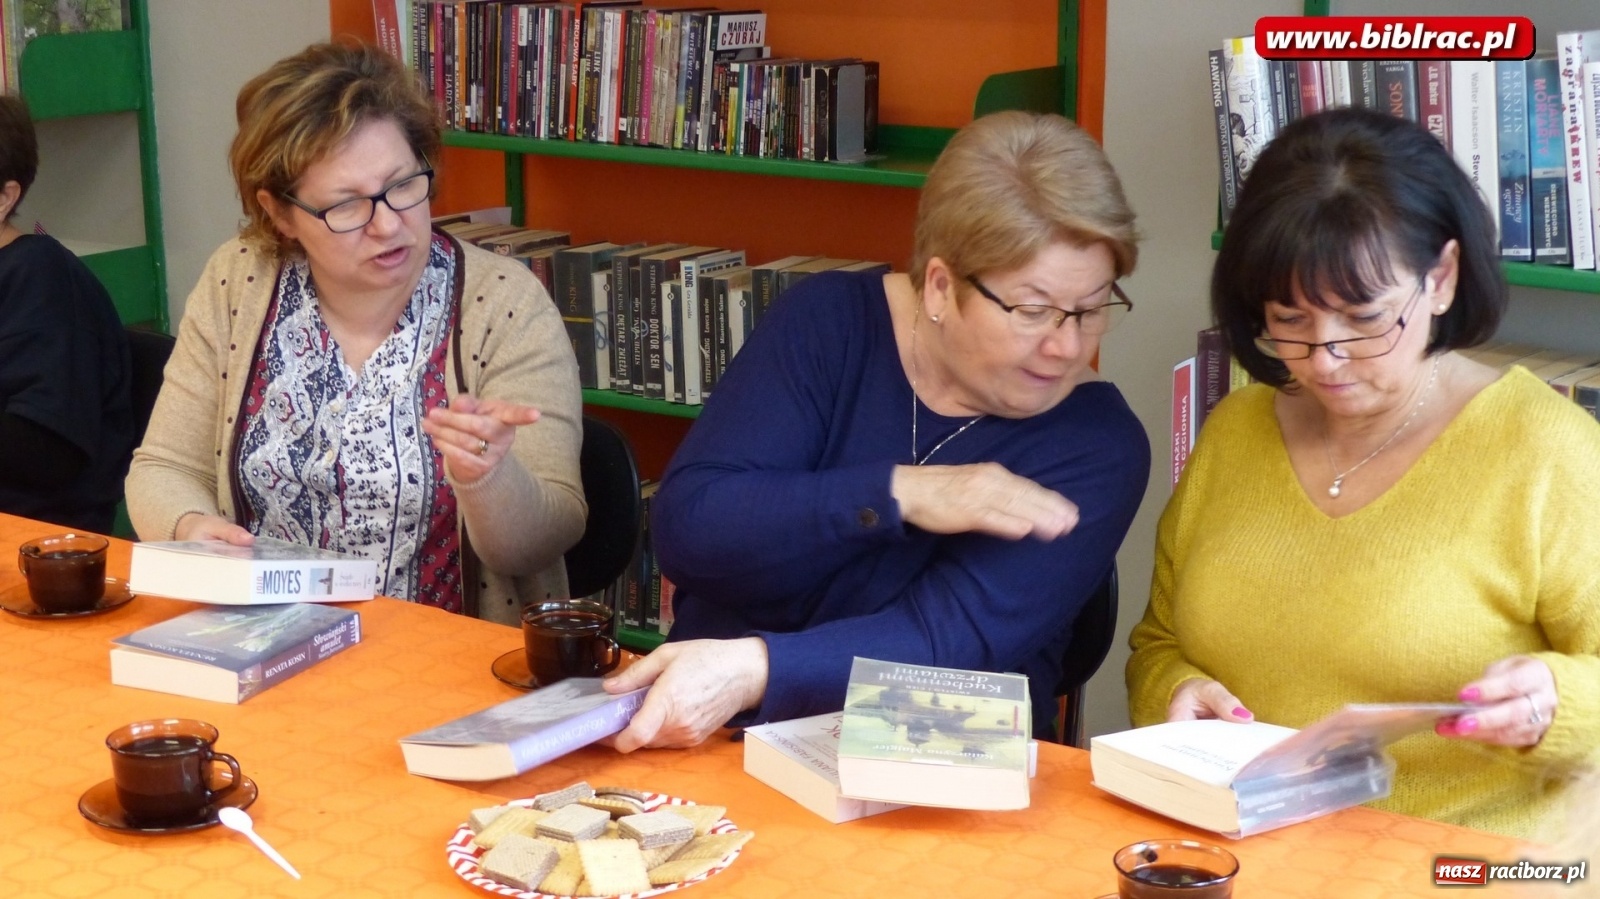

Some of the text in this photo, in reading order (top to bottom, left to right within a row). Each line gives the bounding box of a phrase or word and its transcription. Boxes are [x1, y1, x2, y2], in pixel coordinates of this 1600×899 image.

[721, 30, 761, 46] CZUBAJ
[727, 20, 758, 32] MARIUSZ
[687, 32, 695, 80] WITKIEWICZ
[1210, 56, 1222, 107] HAWKING
[1429, 82, 1438, 106] Barker
[1470, 72, 1480, 104] Walter
[1502, 71, 1512, 133] HANNAH
[1513, 71, 1522, 133] KRISTIN
[1548, 94, 1560, 137] LIANE
[1218, 114, 1229, 145] KRÓTKA
[1471, 106, 1480, 150] Isaacson
[1534, 78, 1550, 156] MORIARTY
[1221, 146, 1232, 182] HISTORIA
[1472, 154, 1481, 182] Steve
[1502, 188, 1514, 216] ogród
[1513, 182, 1524, 223] Zimowy
[1550, 184, 1558, 236] DZIEWIĘCIORO
[1544, 196, 1552, 249] NIEZNAJOMYC
[684, 271, 693, 288] KING
[569, 286, 578, 312] KING
[633, 297, 641, 312] Cujo
[616, 314, 625, 343] CMĘTARZ
[650, 318, 660, 350] DOKTOR
[618, 347, 627, 377] ZWIEŻĄT
[650, 354, 660, 369] SEN
[263, 570, 301, 595] MOYES
[265, 660, 288, 678] RENATA
[288, 652, 306, 668] KOSIN
[894, 666, 988, 684] drzwiami
[878, 672, 1002, 694] Kuchennymi
[926, 748, 994, 761] Katarzyna
